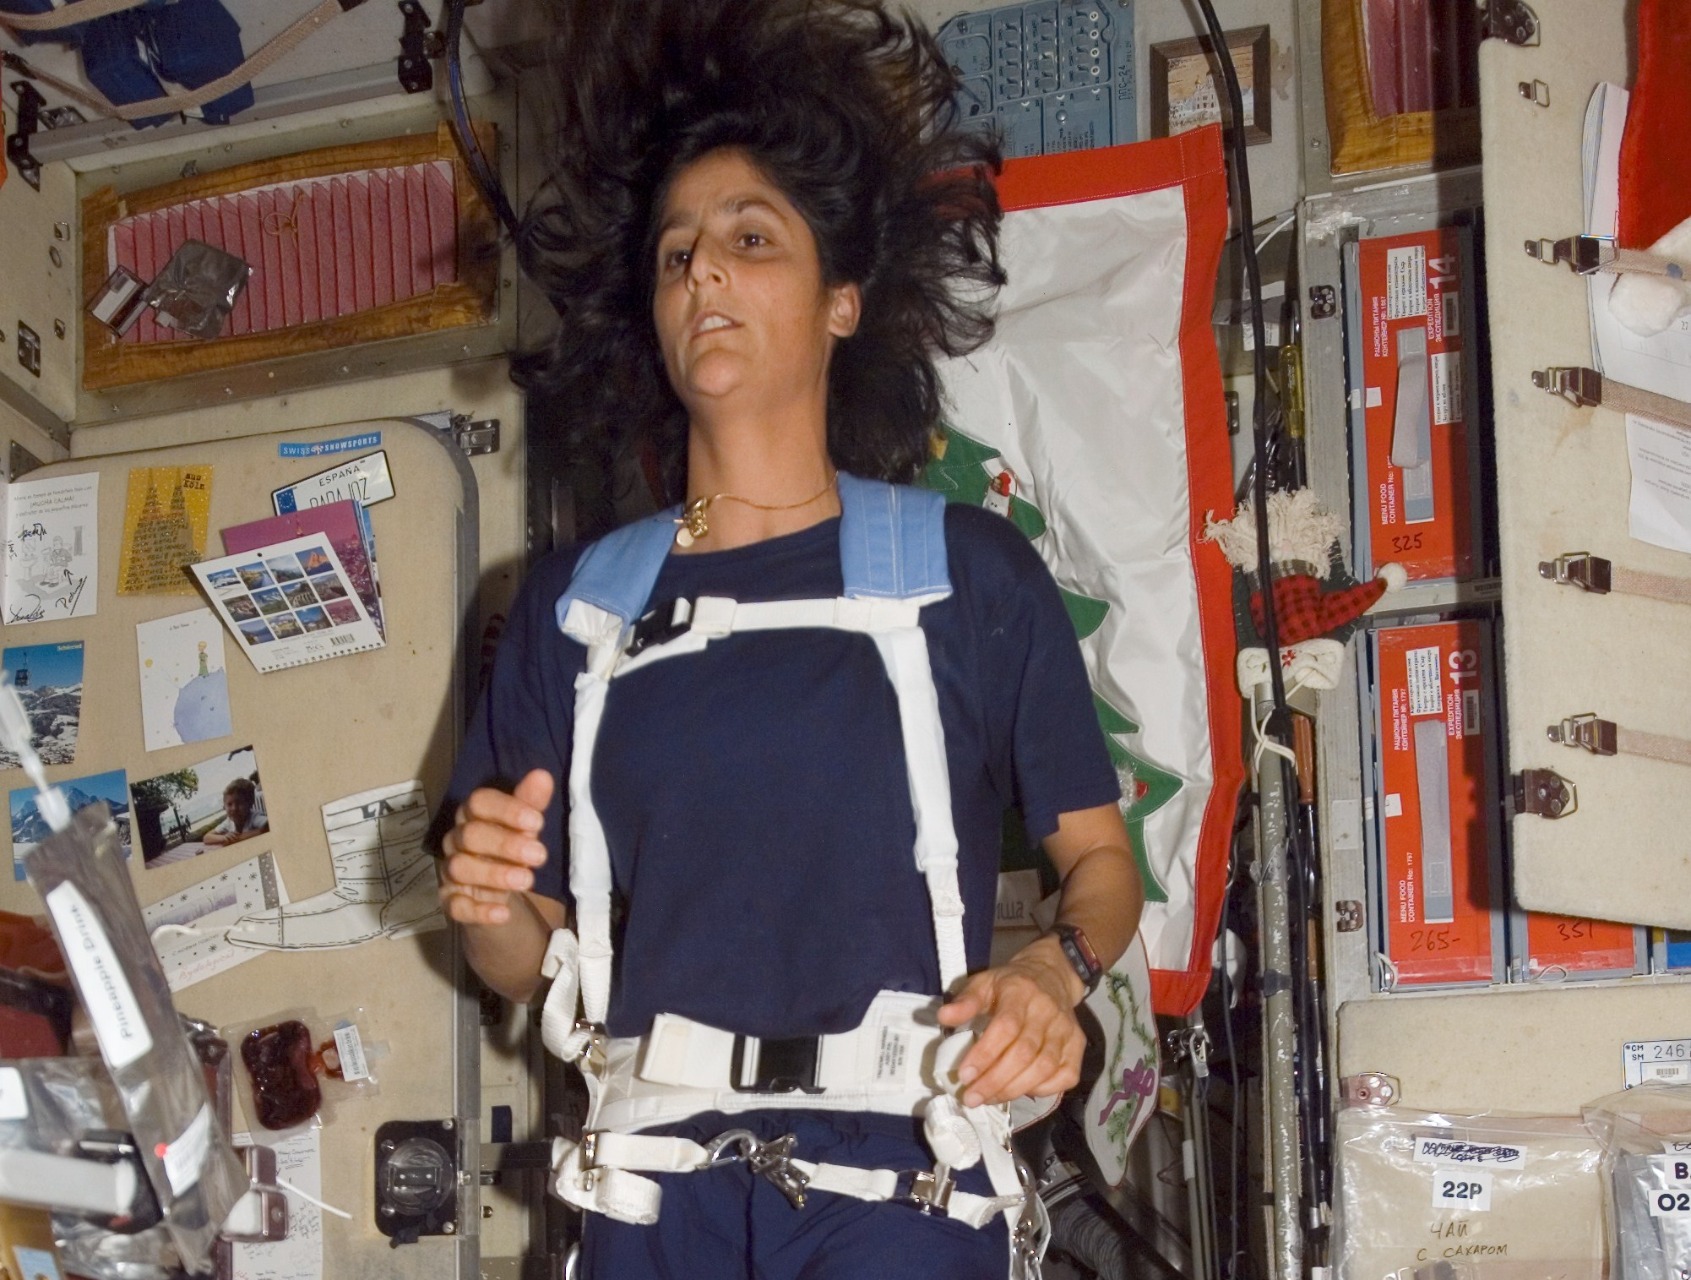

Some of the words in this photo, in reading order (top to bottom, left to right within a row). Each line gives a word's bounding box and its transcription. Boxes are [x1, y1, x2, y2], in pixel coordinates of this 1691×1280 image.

[1428, 254, 1456, 289] 14
[1434, 293, 1442, 342] ЭКСПЕДИЦИЯ
[282, 445, 313, 457] SWISS
[323, 435, 378, 453] SNOWSPORTS
[318, 464, 362, 489] ESPAÑA
[1388, 484, 1396, 523] CONTAINER
[1392, 532, 1423, 553] 325
[1448, 649, 1477, 684] 13
[1454, 689, 1462, 739] ЭКСПЕДИЦИЯ
[1407, 881, 1415, 922] CONTAINER
[68, 904, 96, 952] Drink
[1557, 920, 1592, 941] 351
[89, 953, 135, 1041] Pineapple
[1654, 1044, 1691, 1058] 246
[1674, 1162, 1691, 1179] B
[1442, 1181, 1482, 1199] 22P
[1430, 1219, 1469, 1239] ЧАЙ
[1443, 1244, 1508, 1258] САХАРОМ
